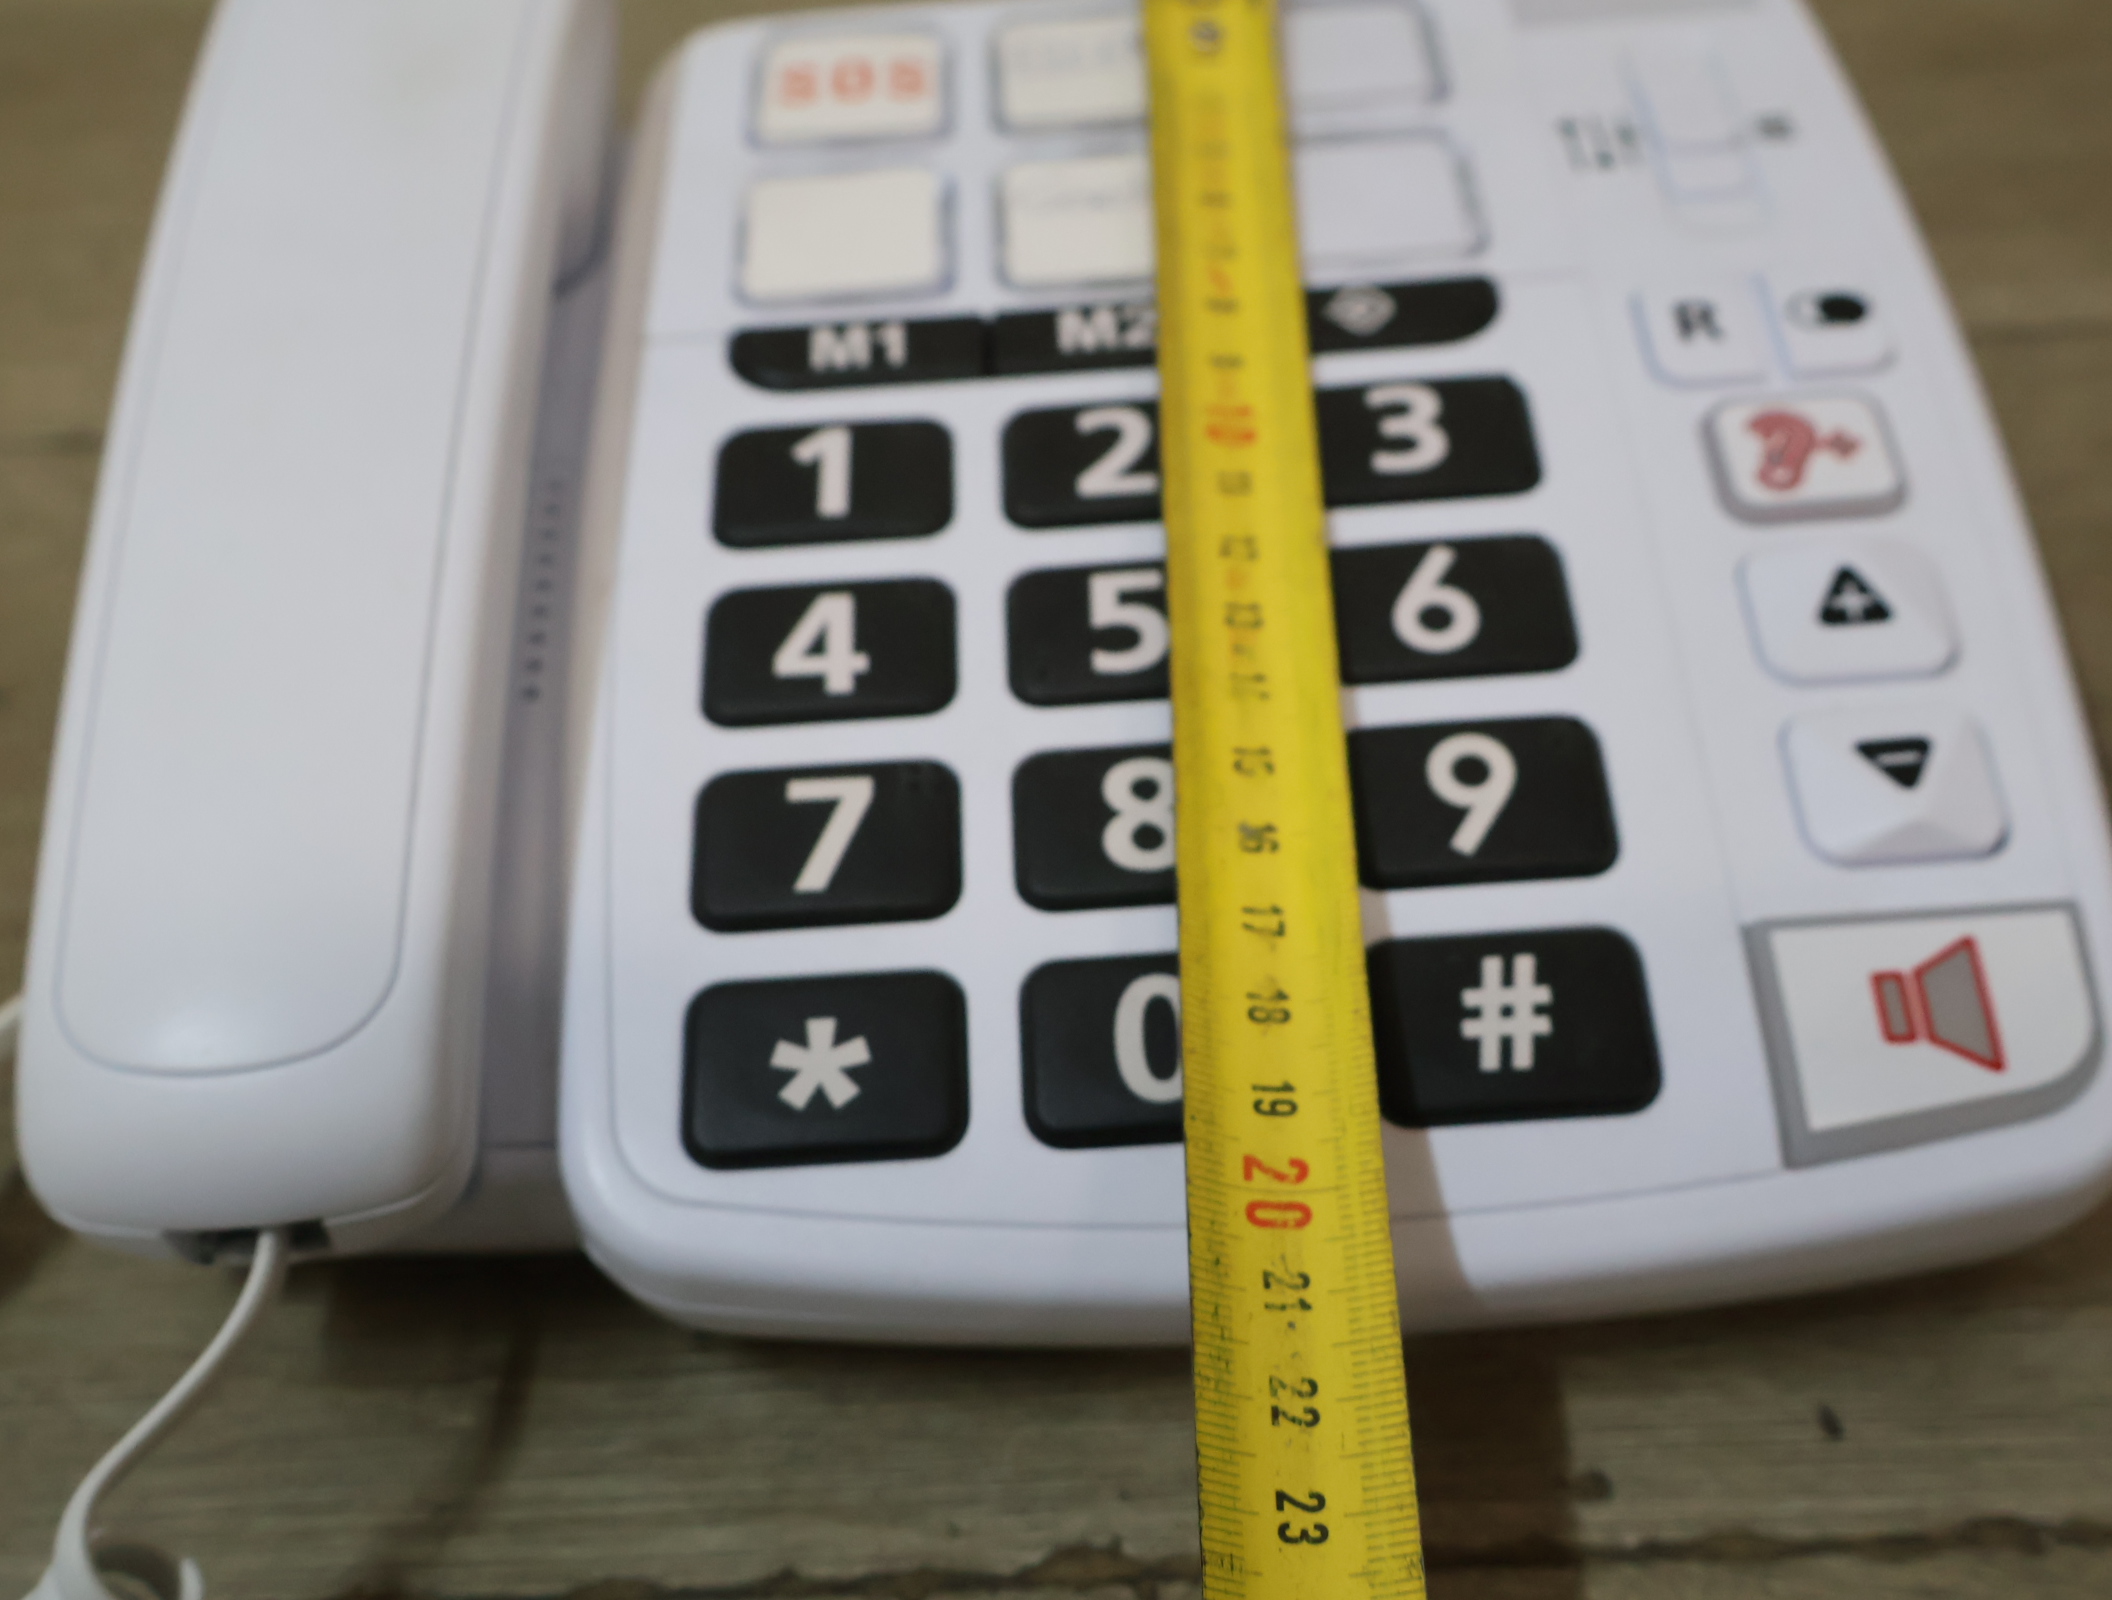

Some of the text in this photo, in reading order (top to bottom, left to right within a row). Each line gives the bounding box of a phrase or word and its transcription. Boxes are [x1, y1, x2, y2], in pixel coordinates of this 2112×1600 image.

[808, 322, 908, 372] M1
[1055, 306, 1156, 356] M2
[1672, 300, 1722, 342] R
[1074, 406, 1159, 497] 2
[1364, 383, 1450, 474] 3
[791, 424, 854, 517] 1
[1087, 569, 1170, 674] 5
[1391, 545, 1481, 654] 6
[771, 591, 870, 695] 4
[1101, 756, 1176, 872] 8
[1425, 733, 1518, 857] 9
[784, 775, 875, 893] 7
[1238, 820, 1279, 854] 16
[1242, 904, 1286, 938] 17
[1113, 972, 1183, 1104] 0
[1246, 990, 1292, 1025] 18
[1252, 1081, 1298, 1118] 19
[1243, 1154, 1312, 1229] 20
[1262, 1269, 1312, 1314] 21
[1268, 1375, 1321, 1429] 22
[1275, 1489, 1329, 1547] 23
